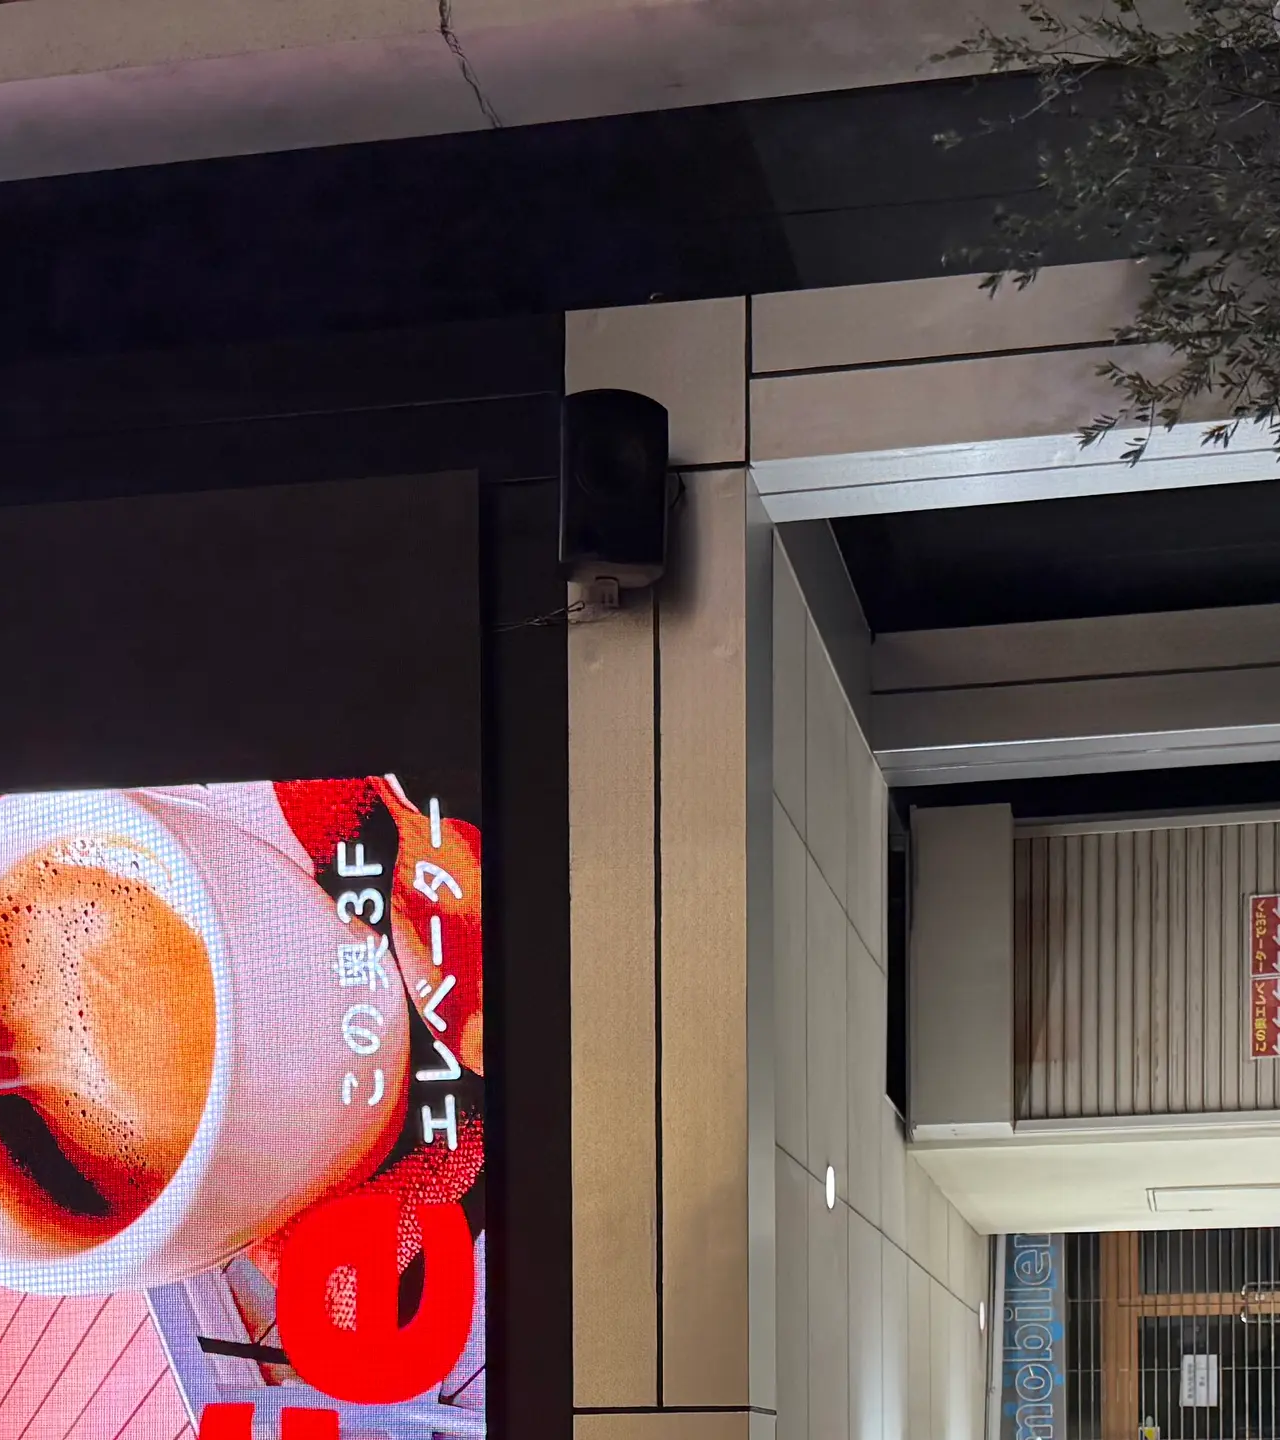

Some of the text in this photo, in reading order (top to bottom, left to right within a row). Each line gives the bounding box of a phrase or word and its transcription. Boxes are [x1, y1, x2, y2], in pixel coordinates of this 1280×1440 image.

[333, 840, 389, 1107] この奥3F
[414, 797, 464, 1151] エレベーター
